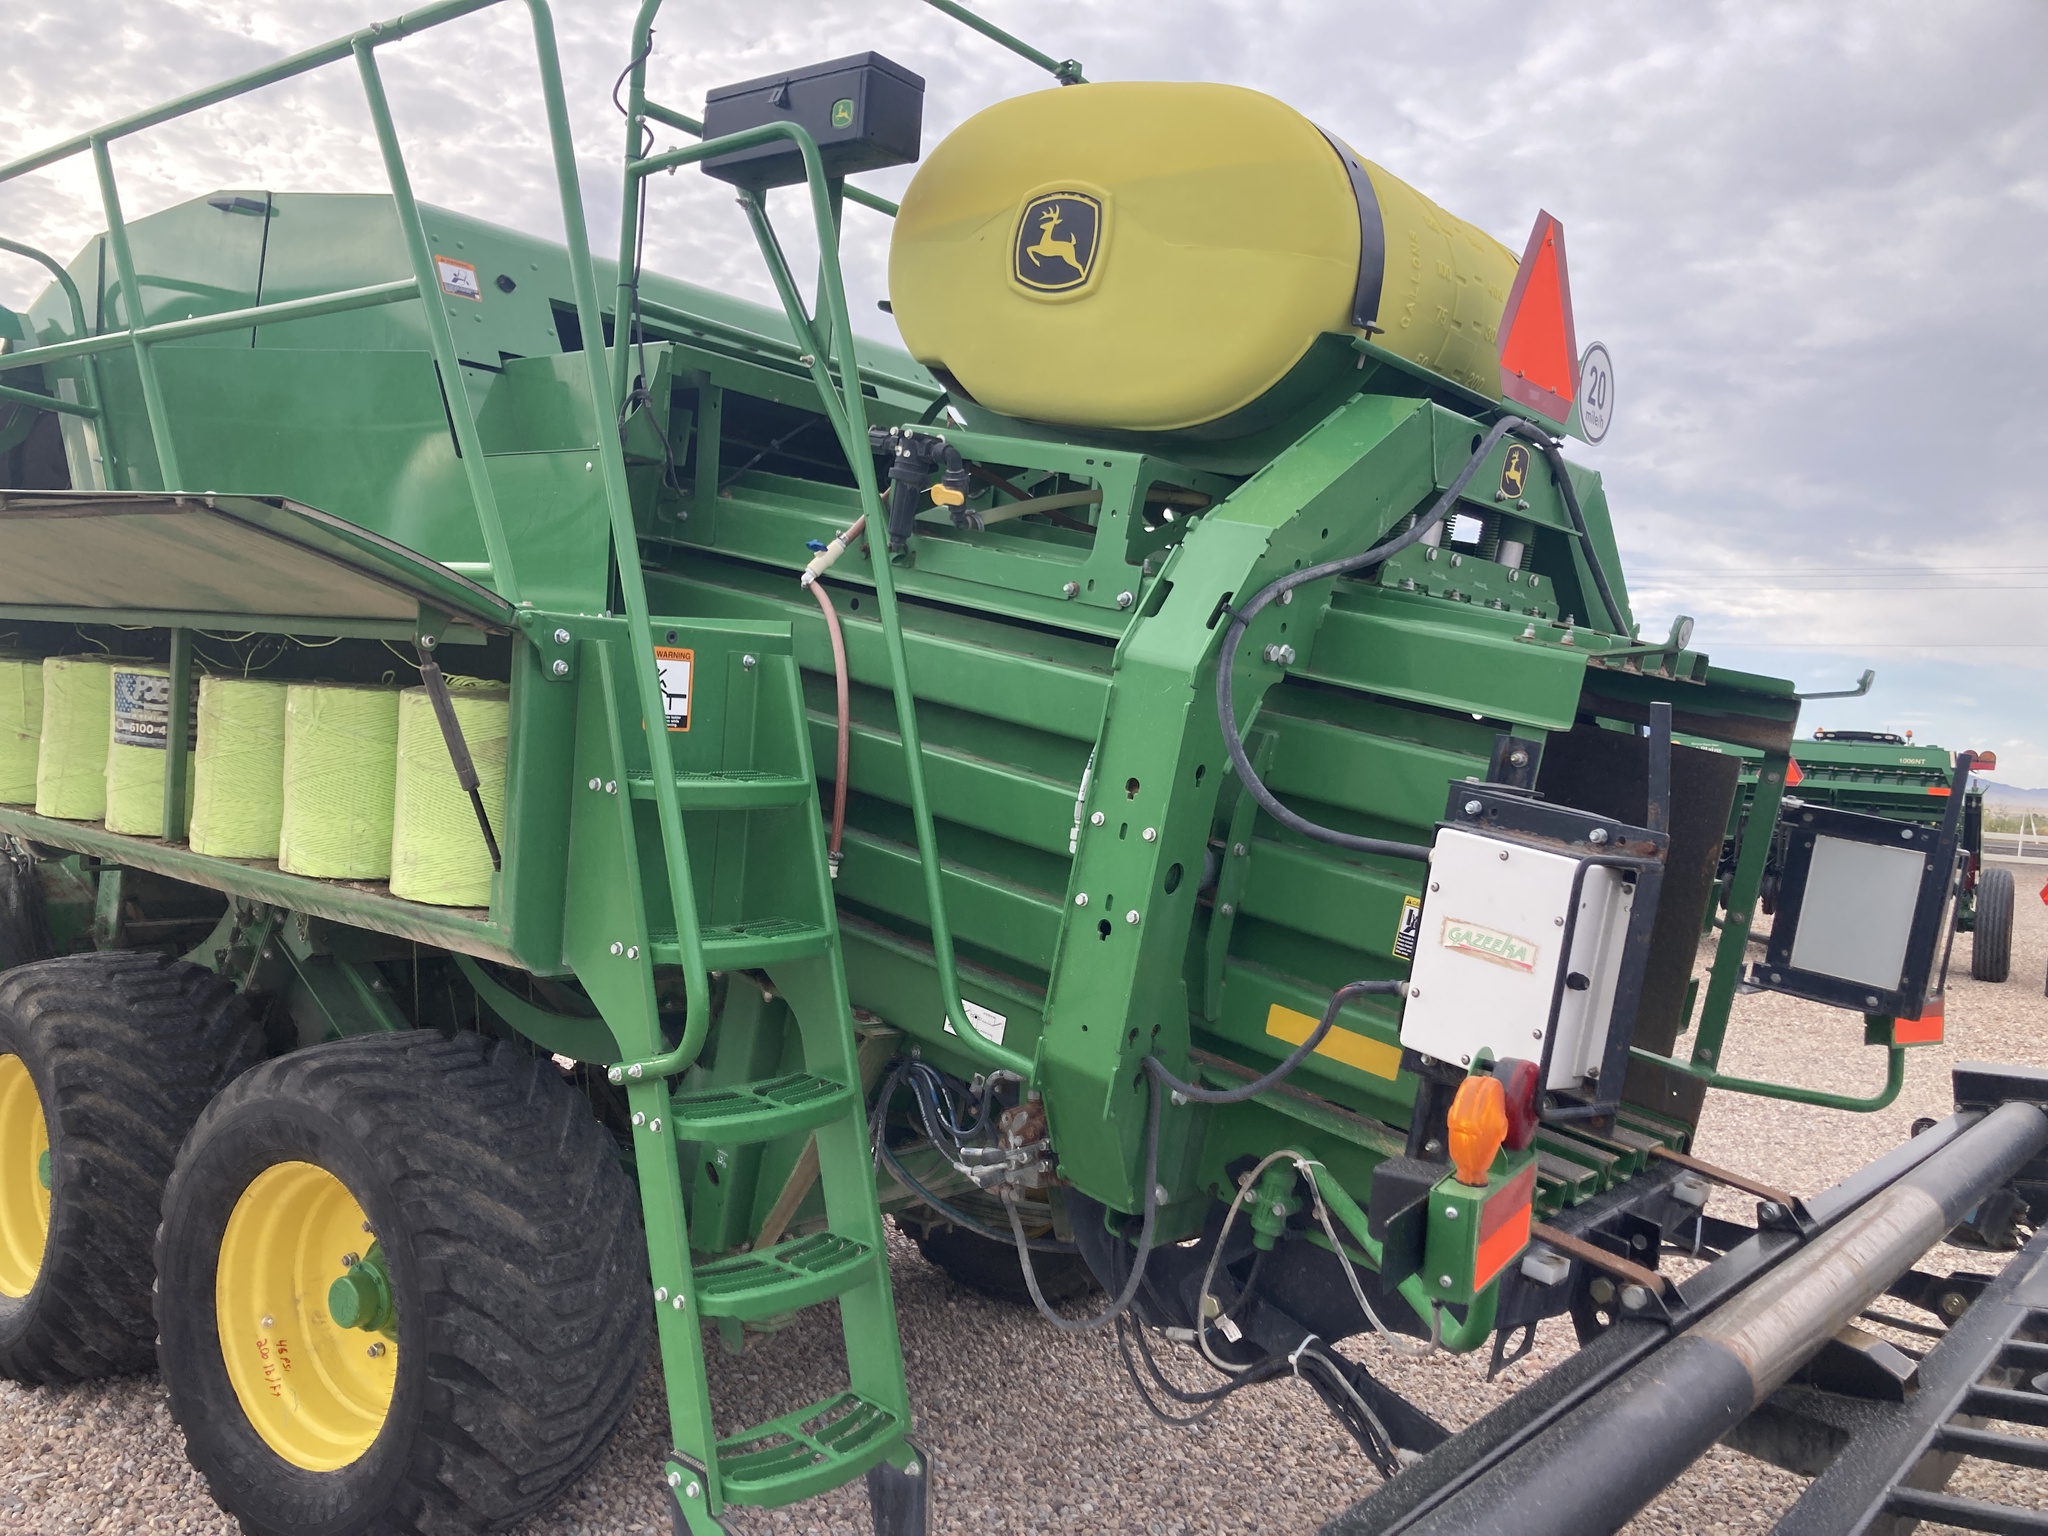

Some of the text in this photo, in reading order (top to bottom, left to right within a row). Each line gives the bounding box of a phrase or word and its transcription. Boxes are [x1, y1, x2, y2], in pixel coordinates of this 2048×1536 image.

[1436, 305, 1448, 325] 75
[1485, 325, 1498, 344] 30
[1465, 372, 1485, 392] 200
[1587, 365, 1606, 410] 20
[1585, 410, 1604, 429] mile/h
[656, 650, 691, 660] WARNING
[129, 722, 167, 735] 6100-4
[1899, 757, 1927, 765] 1006NT
[256, 1339, 270, 1360] 200
